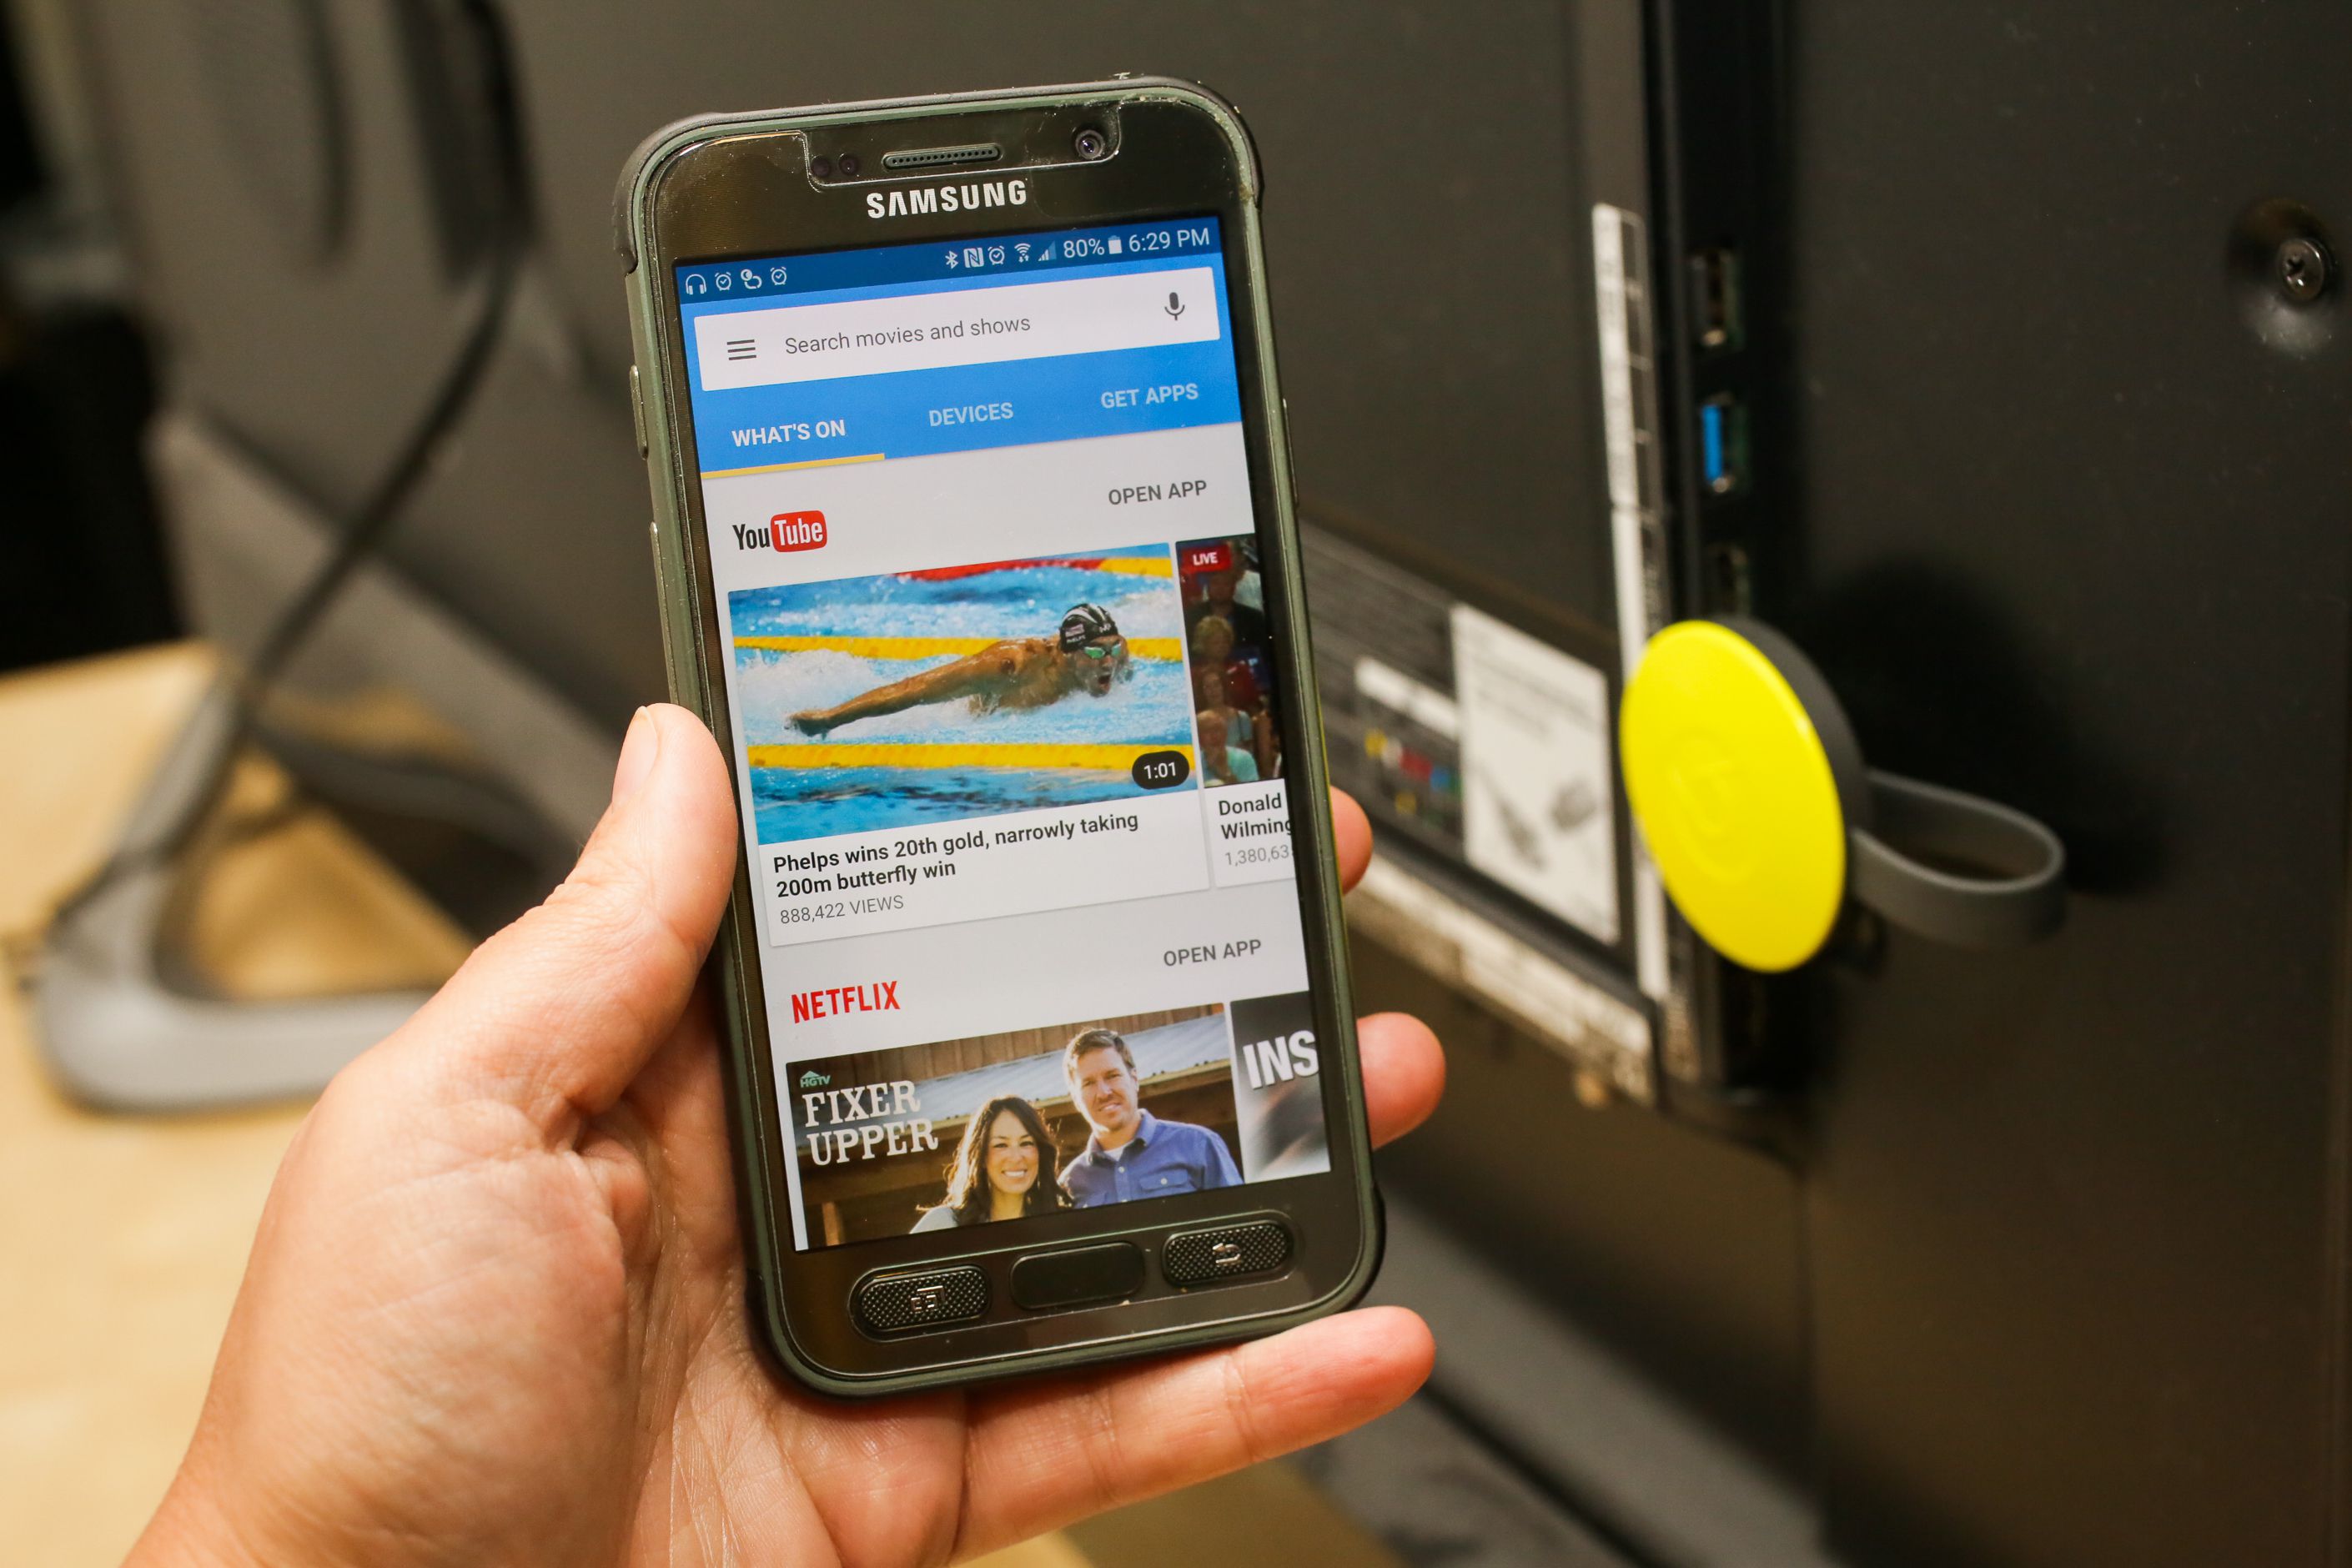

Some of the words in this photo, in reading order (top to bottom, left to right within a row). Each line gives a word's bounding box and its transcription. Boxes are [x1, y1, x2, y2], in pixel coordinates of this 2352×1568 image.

[867, 179, 1027, 219] SAMSUNG
[1063, 238, 1106, 259] 80%
[1128, 231, 1171, 253] 6:29
[1177, 226, 1210, 248] PM
[785, 332, 851, 354] Search
[856, 326, 925, 345] movies
[930, 319, 965, 340] and
[970, 313, 1032, 334] shows
[1100, 387, 1140, 410] GET
[1145, 382, 1199, 405] APPS
[928, 401, 1014, 428] DEVICES
[731, 424, 811, 448] WHAT'S
[814, 419, 847, 440] ON
[1108, 483, 1162, 505] OPEN
[1167, 478, 1208, 500] APP
[731, 515, 825, 548] YouTube
[1193, 551, 1219, 566] LIVE
[1143, 761, 1176, 779] 1:01
[1219, 792, 1282, 816] Donald
[773, 852, 840, 872] Phelps
[845, 846, 889, 863] wins
[894, 837, 937, 857] 20th
[943, 831, 989, 856] gold,
[995, 820, 1075, 846] narrowly
[1080, 814, 1138, 834] taking
[1225, 844, 1294, 867] 1,380,63
[776, 877, 832, 897] 200m
[837, 865, 917, 890] butterfly
[923, 860, 956, 878] win
[780, 902, 845, 924] 888,422
[849, 895, 904, 914] VIEWS
[1163, 945, 1217, 967] OPEN
[1223, 939, 1263, 960] APP
[792, 981, 901, 1024] NETFLIX
[1243, 1030, 1319, 1089] INS
[800, 1074, 832, 1088] HGTV
[802, 1080, 921, 1128] FIXER
[807, 1118, 939, 1166] UPPER
